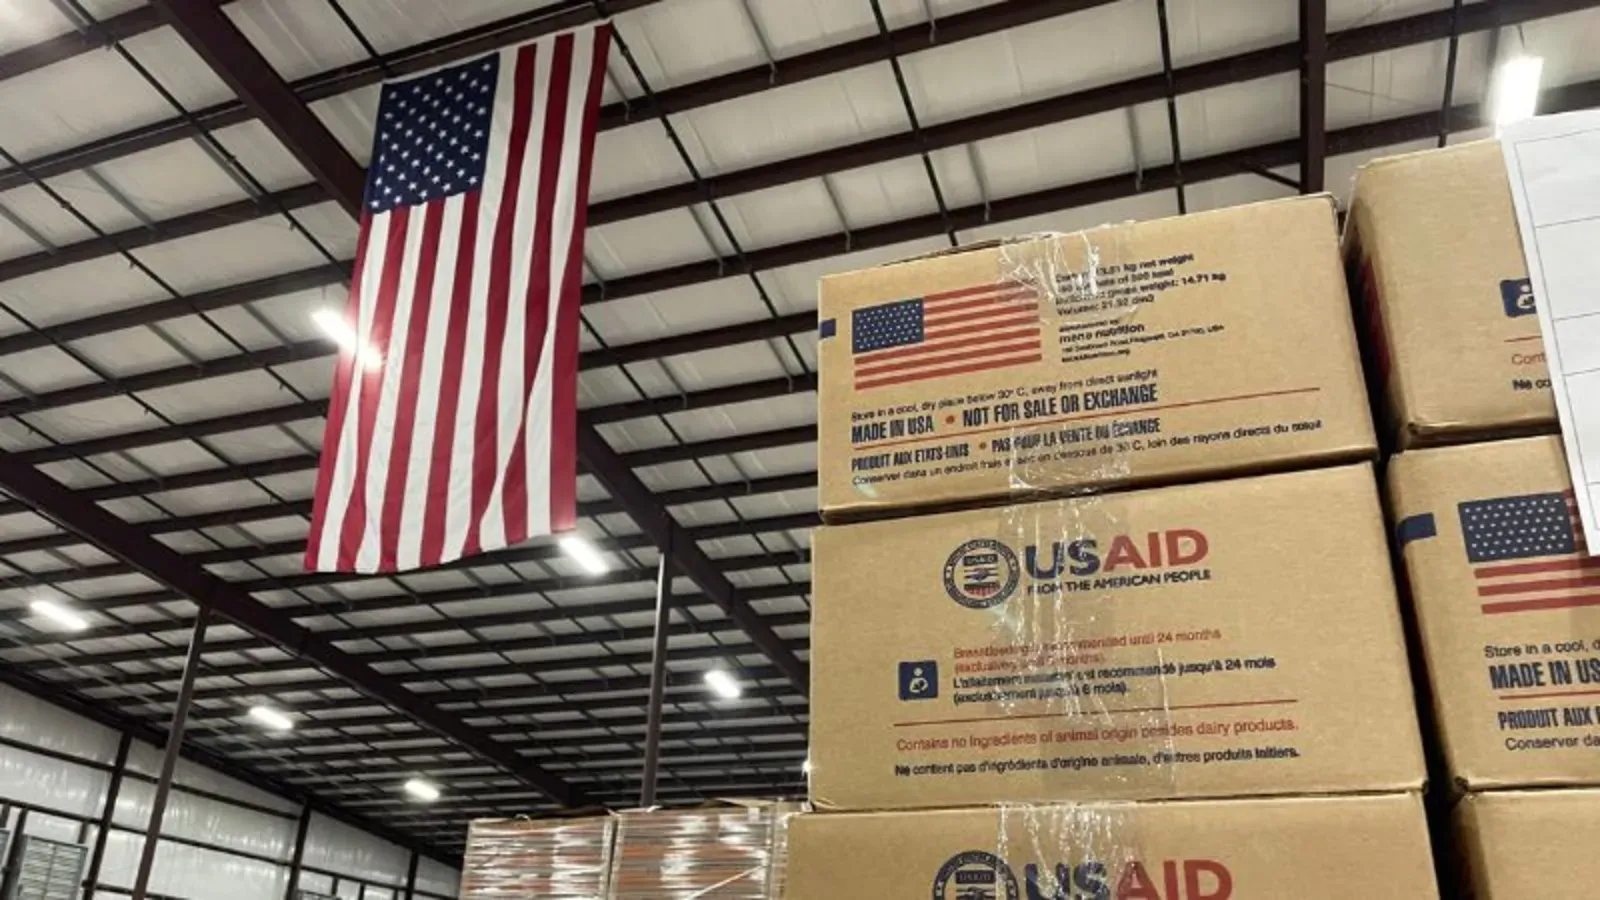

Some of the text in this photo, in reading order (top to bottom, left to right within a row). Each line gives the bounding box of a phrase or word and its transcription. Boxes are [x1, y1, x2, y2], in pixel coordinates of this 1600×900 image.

[1159, 253, 1194, 267] weight
[888, 408, 895, 416] a
[921, 400, 936, 413] dry
[1059, 379, 1084, 390] from
[851, 383, 1159, 443] MADE IN USA NOT FOR SALE OR EXCHANGE
[1170, 435, 1190, 446] des
[1193, 430, 1231, 444] rayons
[1273, 422, 1289, 434] du
[851, 453, 891, 472] PRODUIT
[893, 449, 914, 466] AUX
[991, 437, 1011, 453] PAS
[1043, 431, 1057, 447] LA
[1059, 426, 1093, 445] VENTE
[1025, 528, 1210, 581] USAID
[1027, 568, 1211, 597] FOM THE AMERICAN PEOPLE
[1129, 632, 1155, 645] until
[1157, 631, 1174, 644] 24
[1176, 628, 1223, 641] months
[1484, 645, 1522, 658] Store
[1525, 643, 1539, 655] in
[1541, 643, 1552, 654] a
[1555, 639, 1589, 653] cool,
[1225, 657, 1242, 671] 24
[1488, 657, 1600, 690] MADE IN US
[1497, 707, 1559, 731] PRODUIT
[1563, 705, 1593, 727] AUX
[896, 736, 949, 752] Contains
[951, 736, 967, 748] no
[1039, 730, 1053, 744] of
[1055, 727, 1098, 742] animal
[1101, 726, 1138, 743] origin
[1196, 721, 1230, 737] dairy
[1233, 718, 1299, 736] products.
[1505, 736, 1579, 751] Conserver
[895, 764, 911, 777] Ne
[1203, 747, 1253, 763] produits
[1024, 859, 1233, 900] USAID
